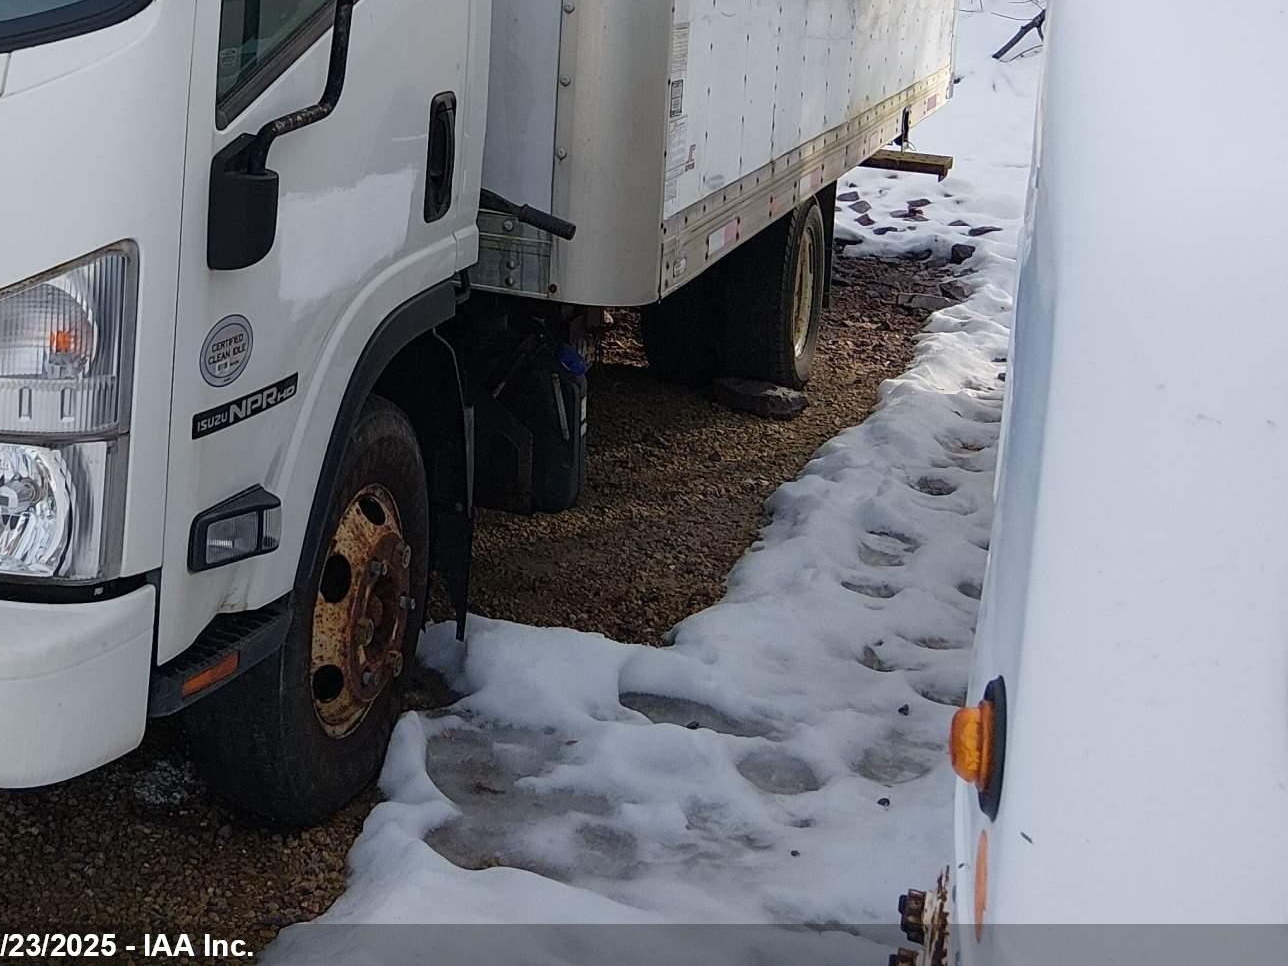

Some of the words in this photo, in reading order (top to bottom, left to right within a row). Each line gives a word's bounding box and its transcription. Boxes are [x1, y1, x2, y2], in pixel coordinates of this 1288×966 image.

[207, 349, 231, 365] CLEAN
[232, 342, 248, 356] IDLE
[212, 333, 244, 353] CERTIFIED
[197, 411, 228, 432] ISUZU
